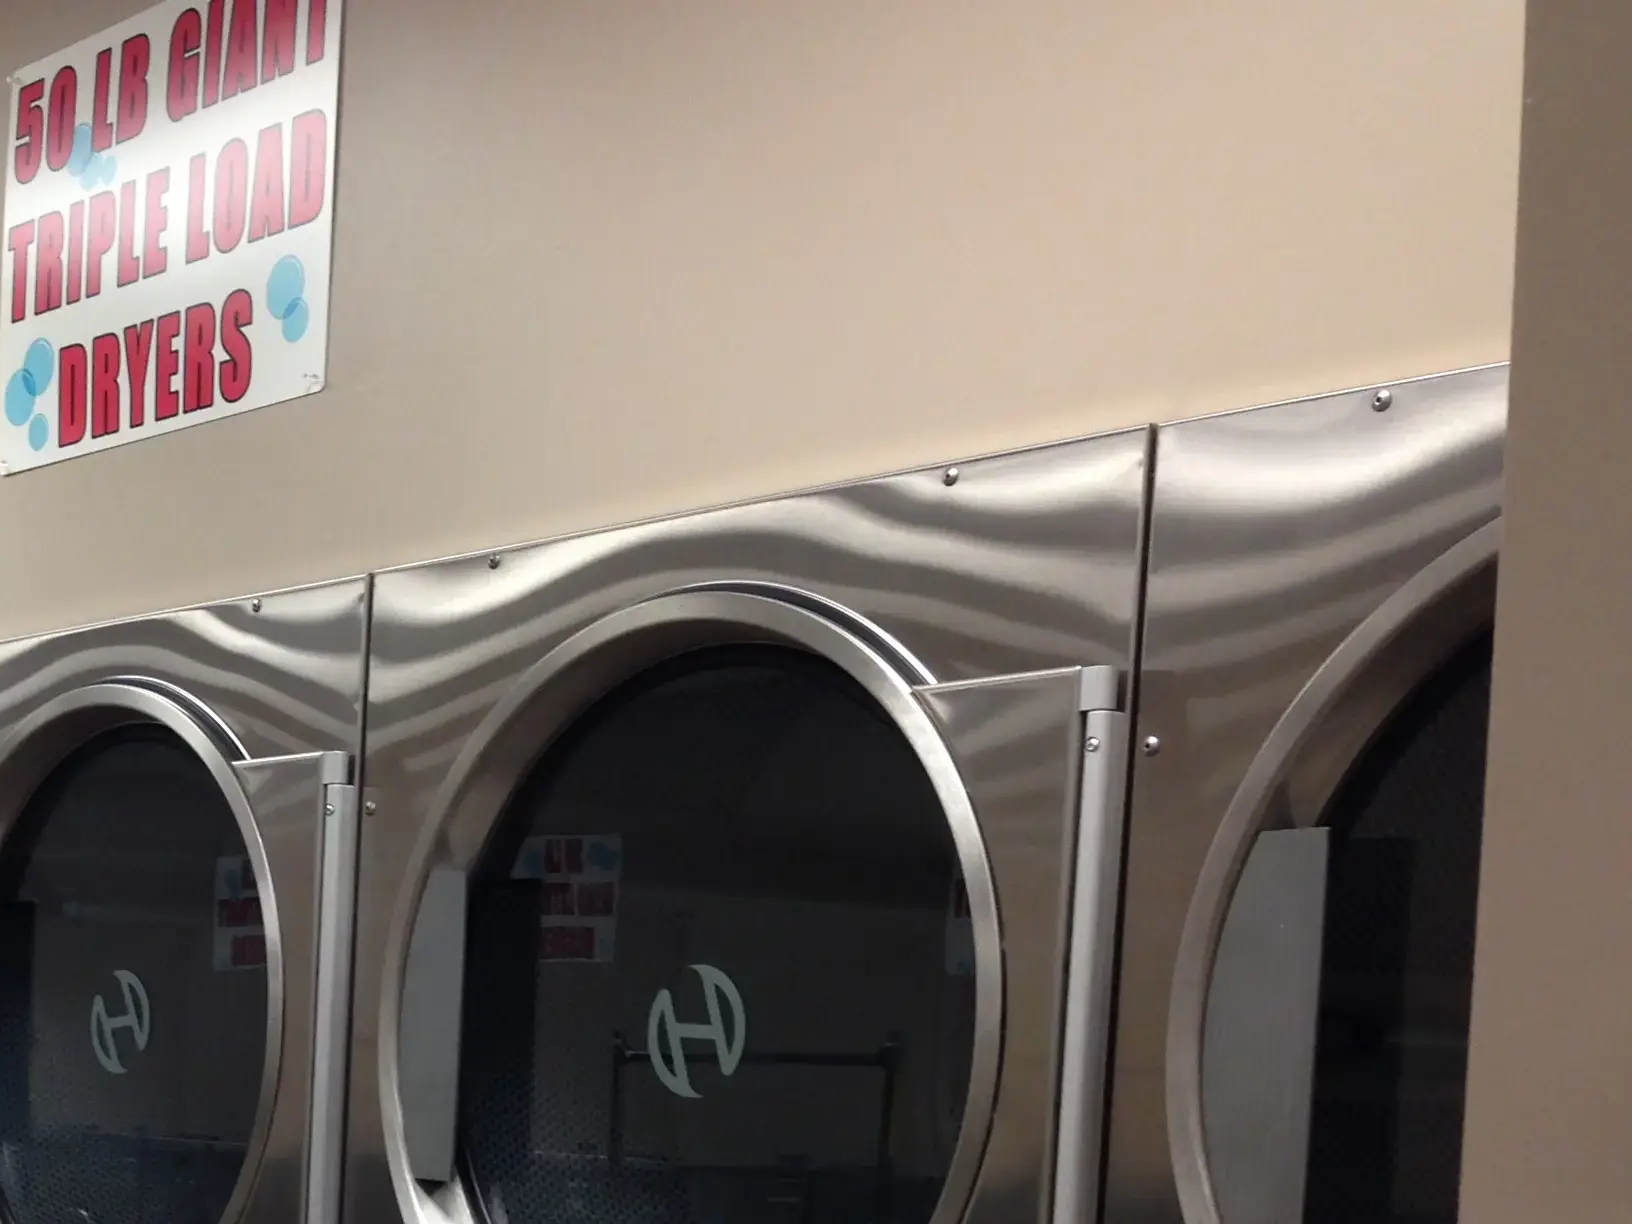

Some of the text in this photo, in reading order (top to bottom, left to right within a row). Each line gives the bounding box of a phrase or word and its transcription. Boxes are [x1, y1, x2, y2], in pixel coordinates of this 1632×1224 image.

[14, 0, 327, 184] 50 LB GIANT
[8, 108, 327, 323] TRIPLE LOAD
[58, 288, 253, 448] DRYERS
[90, 969, 151, 1074] H
[647, 964, 747, 1098] H
